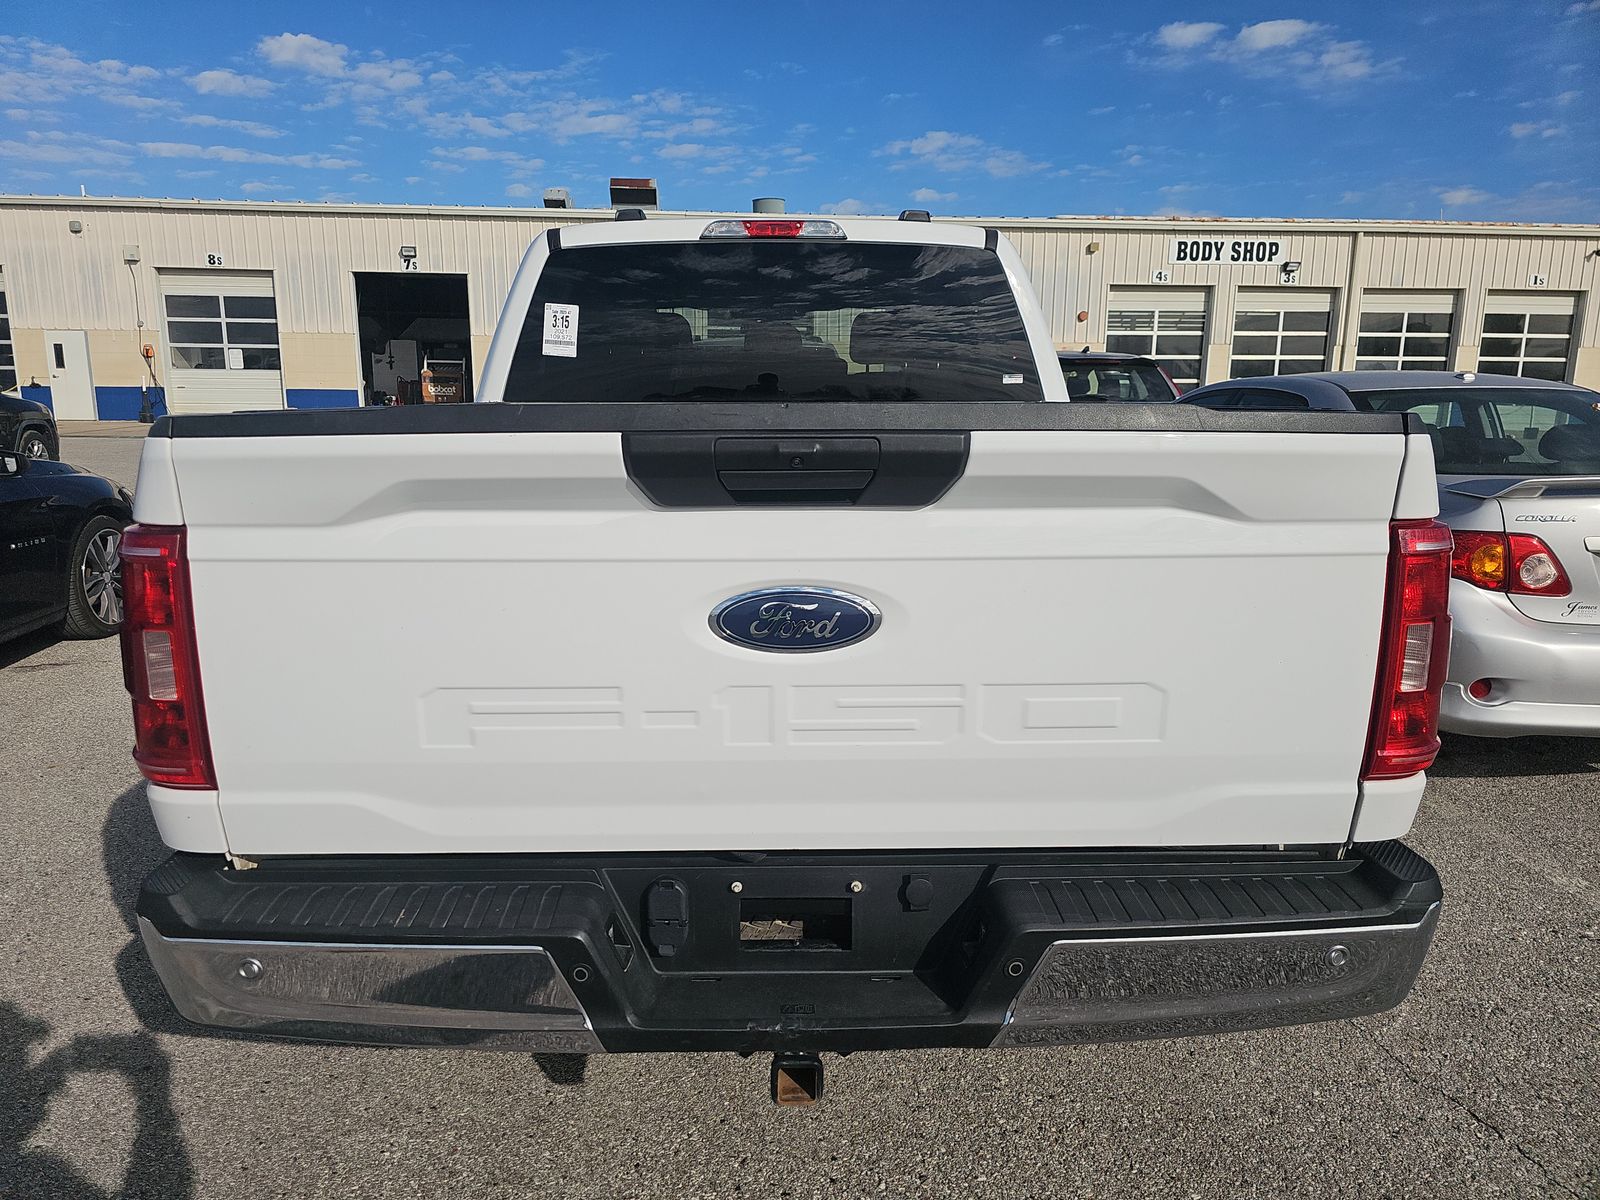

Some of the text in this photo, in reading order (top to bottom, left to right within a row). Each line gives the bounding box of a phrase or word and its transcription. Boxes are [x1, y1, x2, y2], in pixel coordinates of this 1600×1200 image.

[1176, 241, 1280, 262] BODY SHOP
[552, 314, 570, 329] 3:15
[428, 384, 456, 393] bobcat
[1514, 514, 1577, 523] COROLLA
[1560, 601, 1598, 618] James
[749, 601, 842, 639] Ford
[418, 683, 1169, 750] F-150
